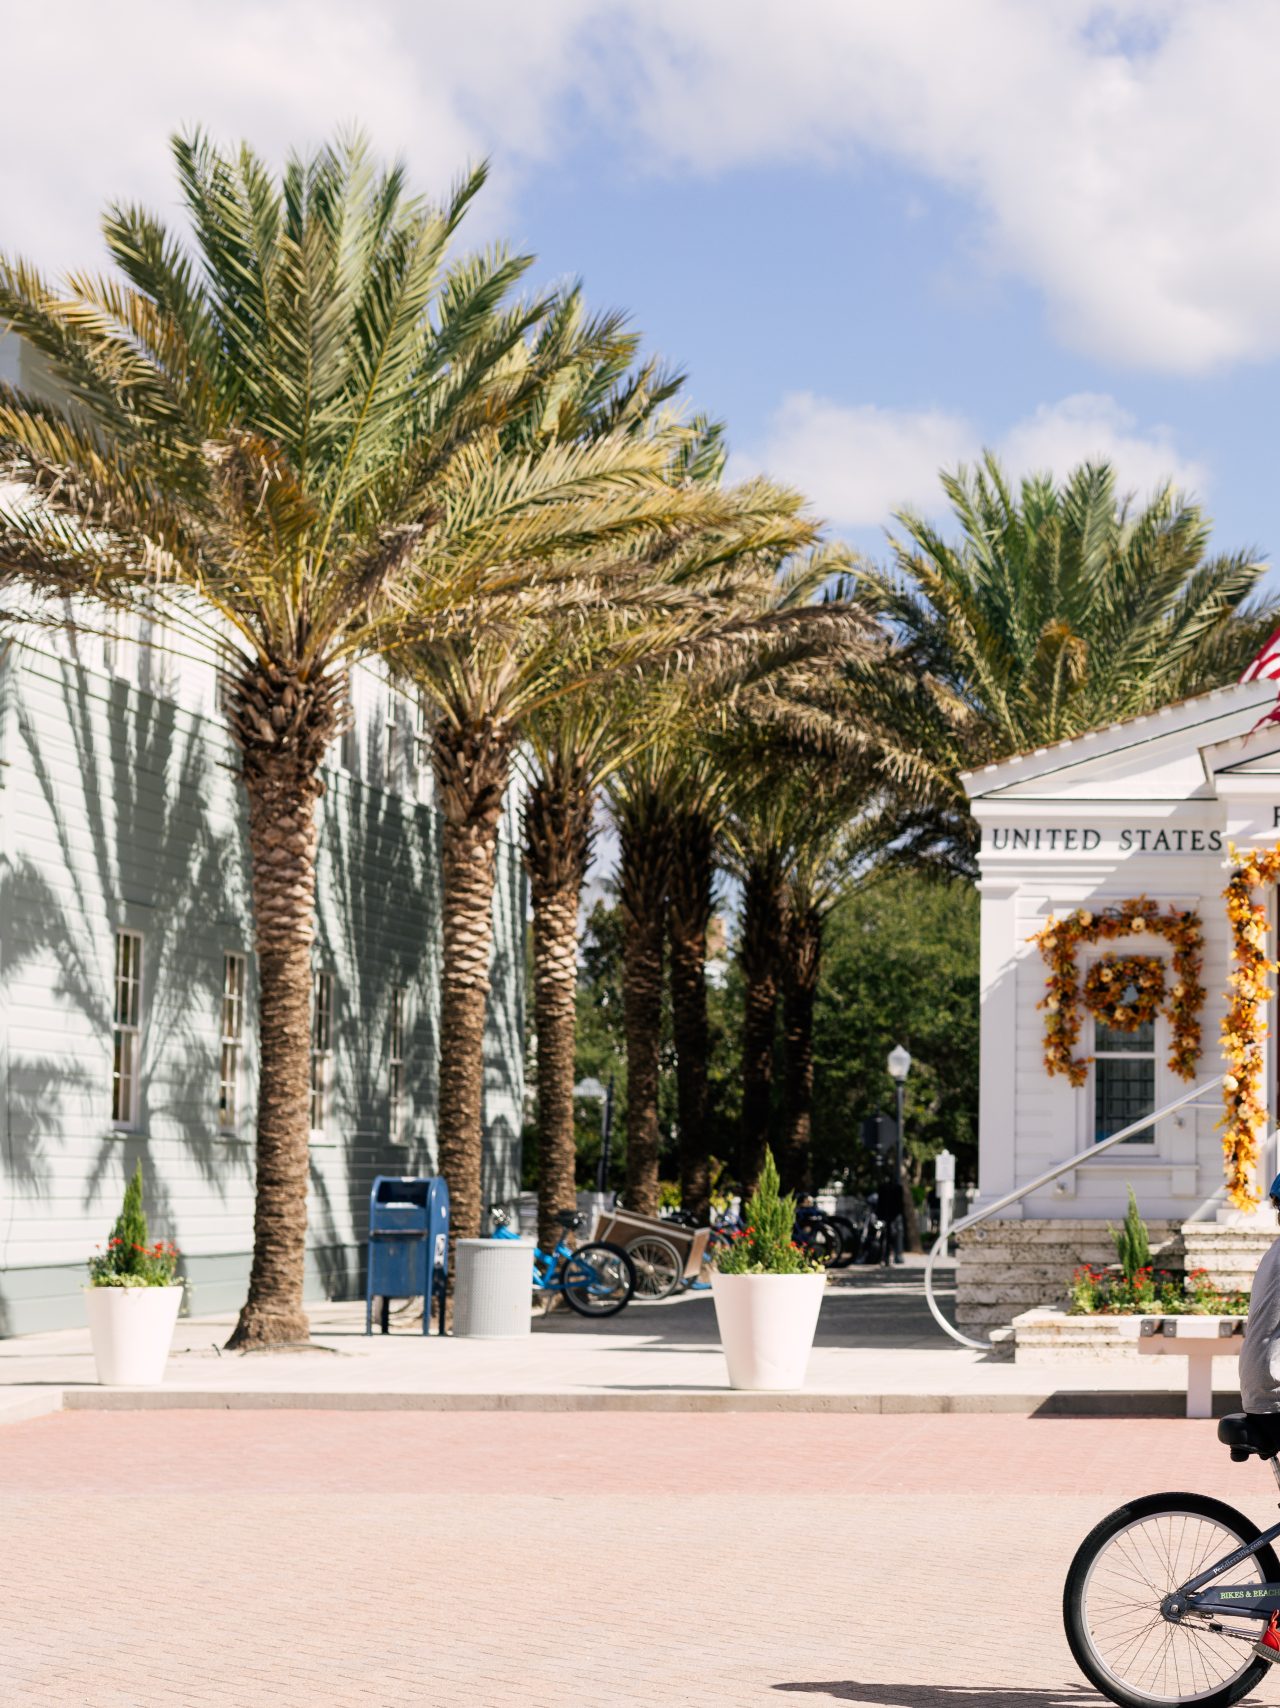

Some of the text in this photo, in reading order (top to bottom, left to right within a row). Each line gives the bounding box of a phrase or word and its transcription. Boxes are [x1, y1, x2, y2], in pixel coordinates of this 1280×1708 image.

[992, 828, 1223, 851] UNITED STATES
[1220, 1590, 1245, 1600] BIKES
[1245, 1590, 1252, 1598] &
[1252, 1588, 1280, 1598] BEACH
